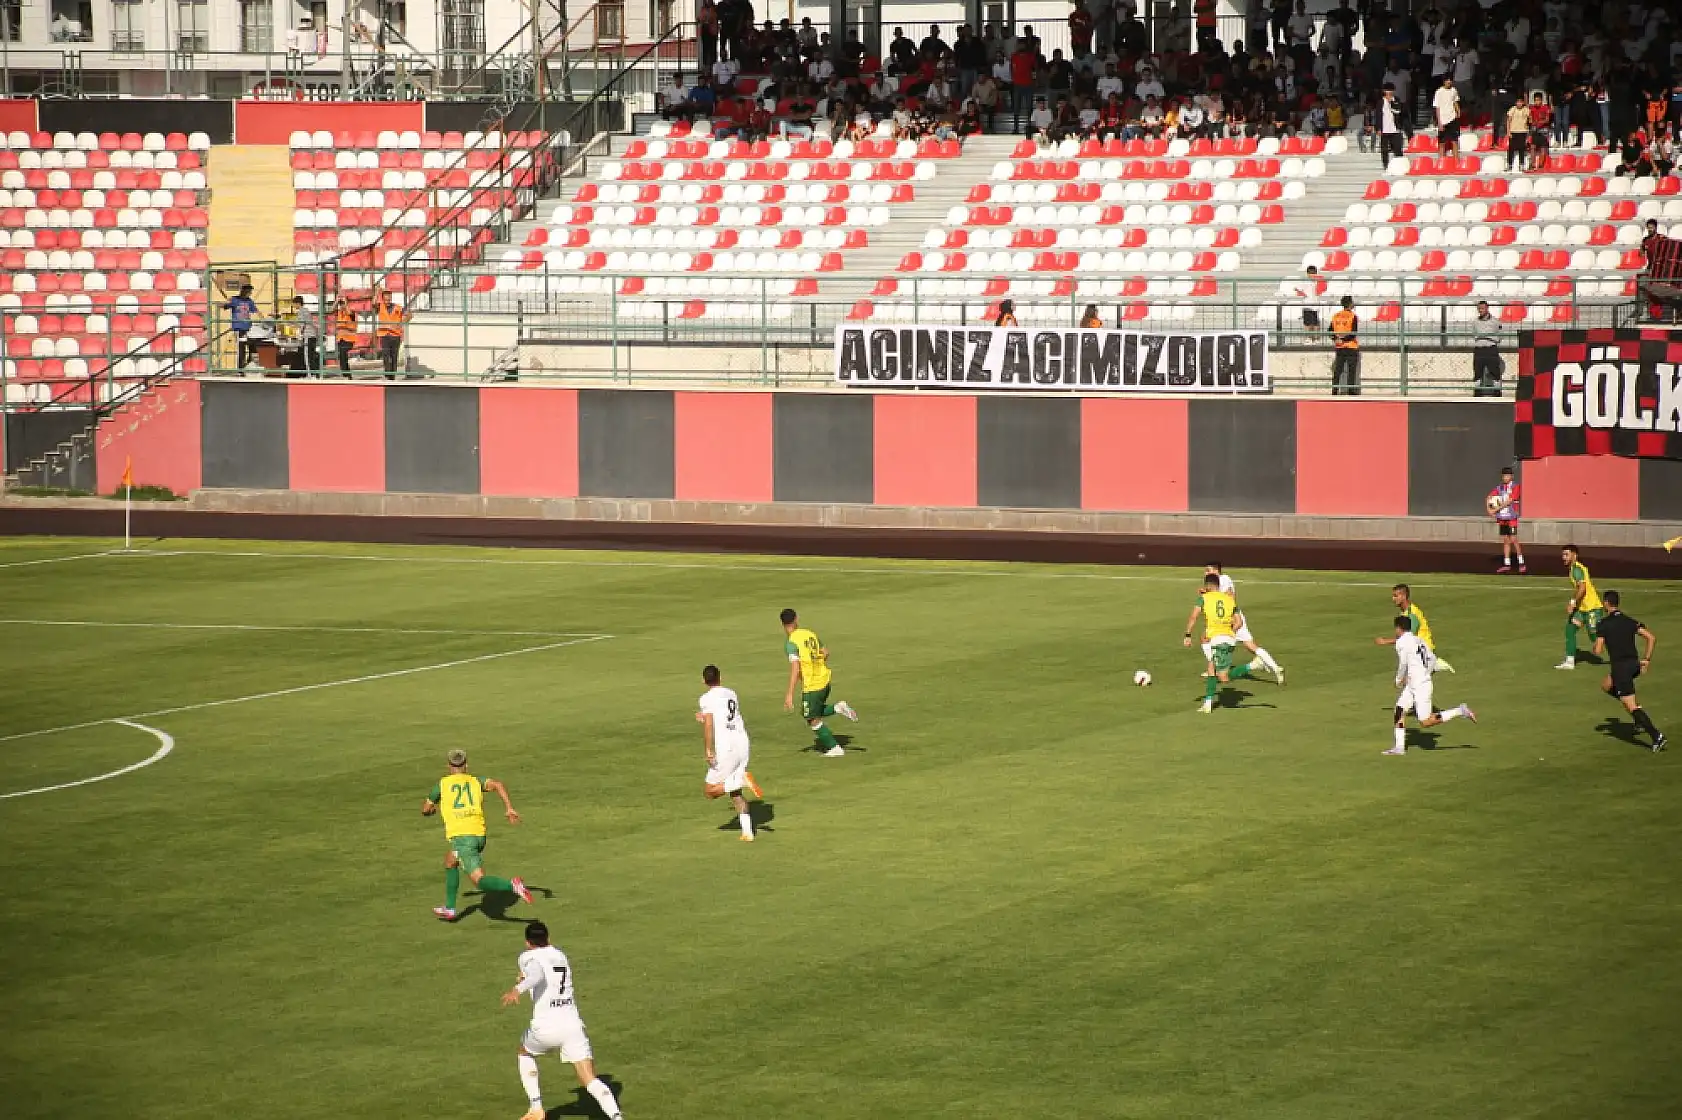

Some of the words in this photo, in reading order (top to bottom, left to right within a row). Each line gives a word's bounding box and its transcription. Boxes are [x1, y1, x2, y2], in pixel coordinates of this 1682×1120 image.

[1215, 599, 1225, 618] 6
[727, 699, 736, 721] 9
[451, 781, 473, 809] 21
[553, 966, 567, 994] 7
